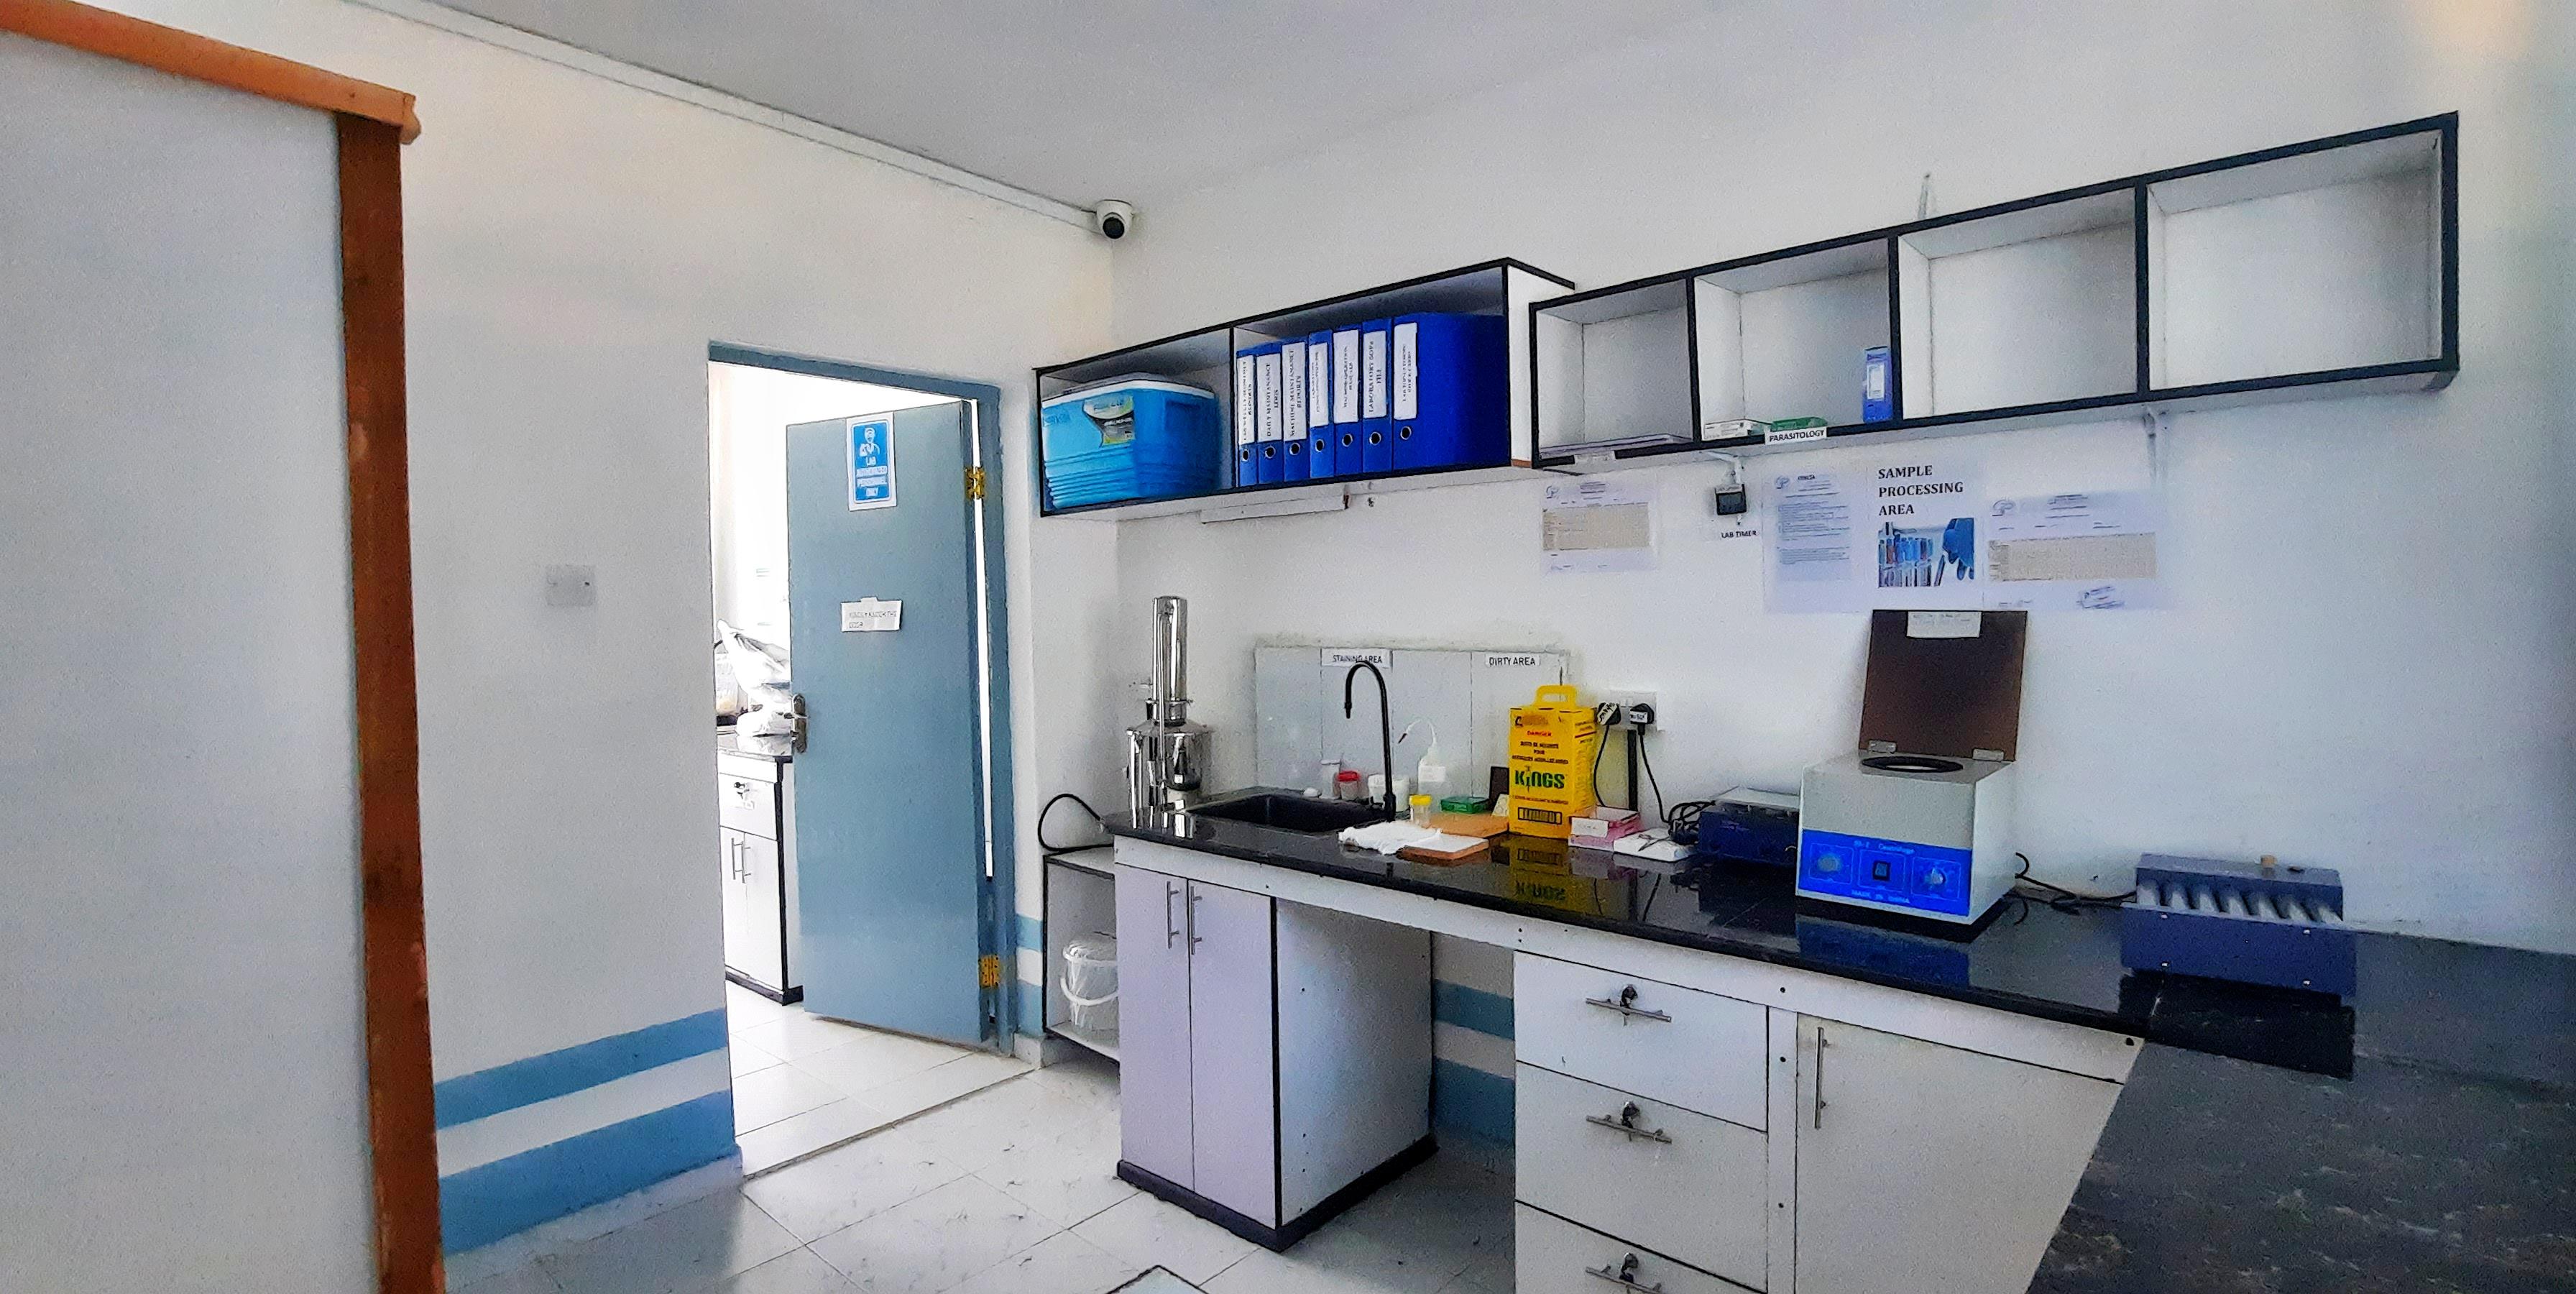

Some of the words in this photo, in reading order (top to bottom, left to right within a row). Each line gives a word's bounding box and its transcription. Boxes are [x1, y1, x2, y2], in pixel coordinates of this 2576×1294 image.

[1769, 430, 1824, 442] PARASITOLOGY
[1878, 465, 1933, 479] SAMPLE
[1878, 482, 1964, 497] PROCESSING
[1879, 504, 1915, 516] AREA
[1489, 656, 1512, 666] DIRTY
[1513, 657, 1536, 666] AREA
